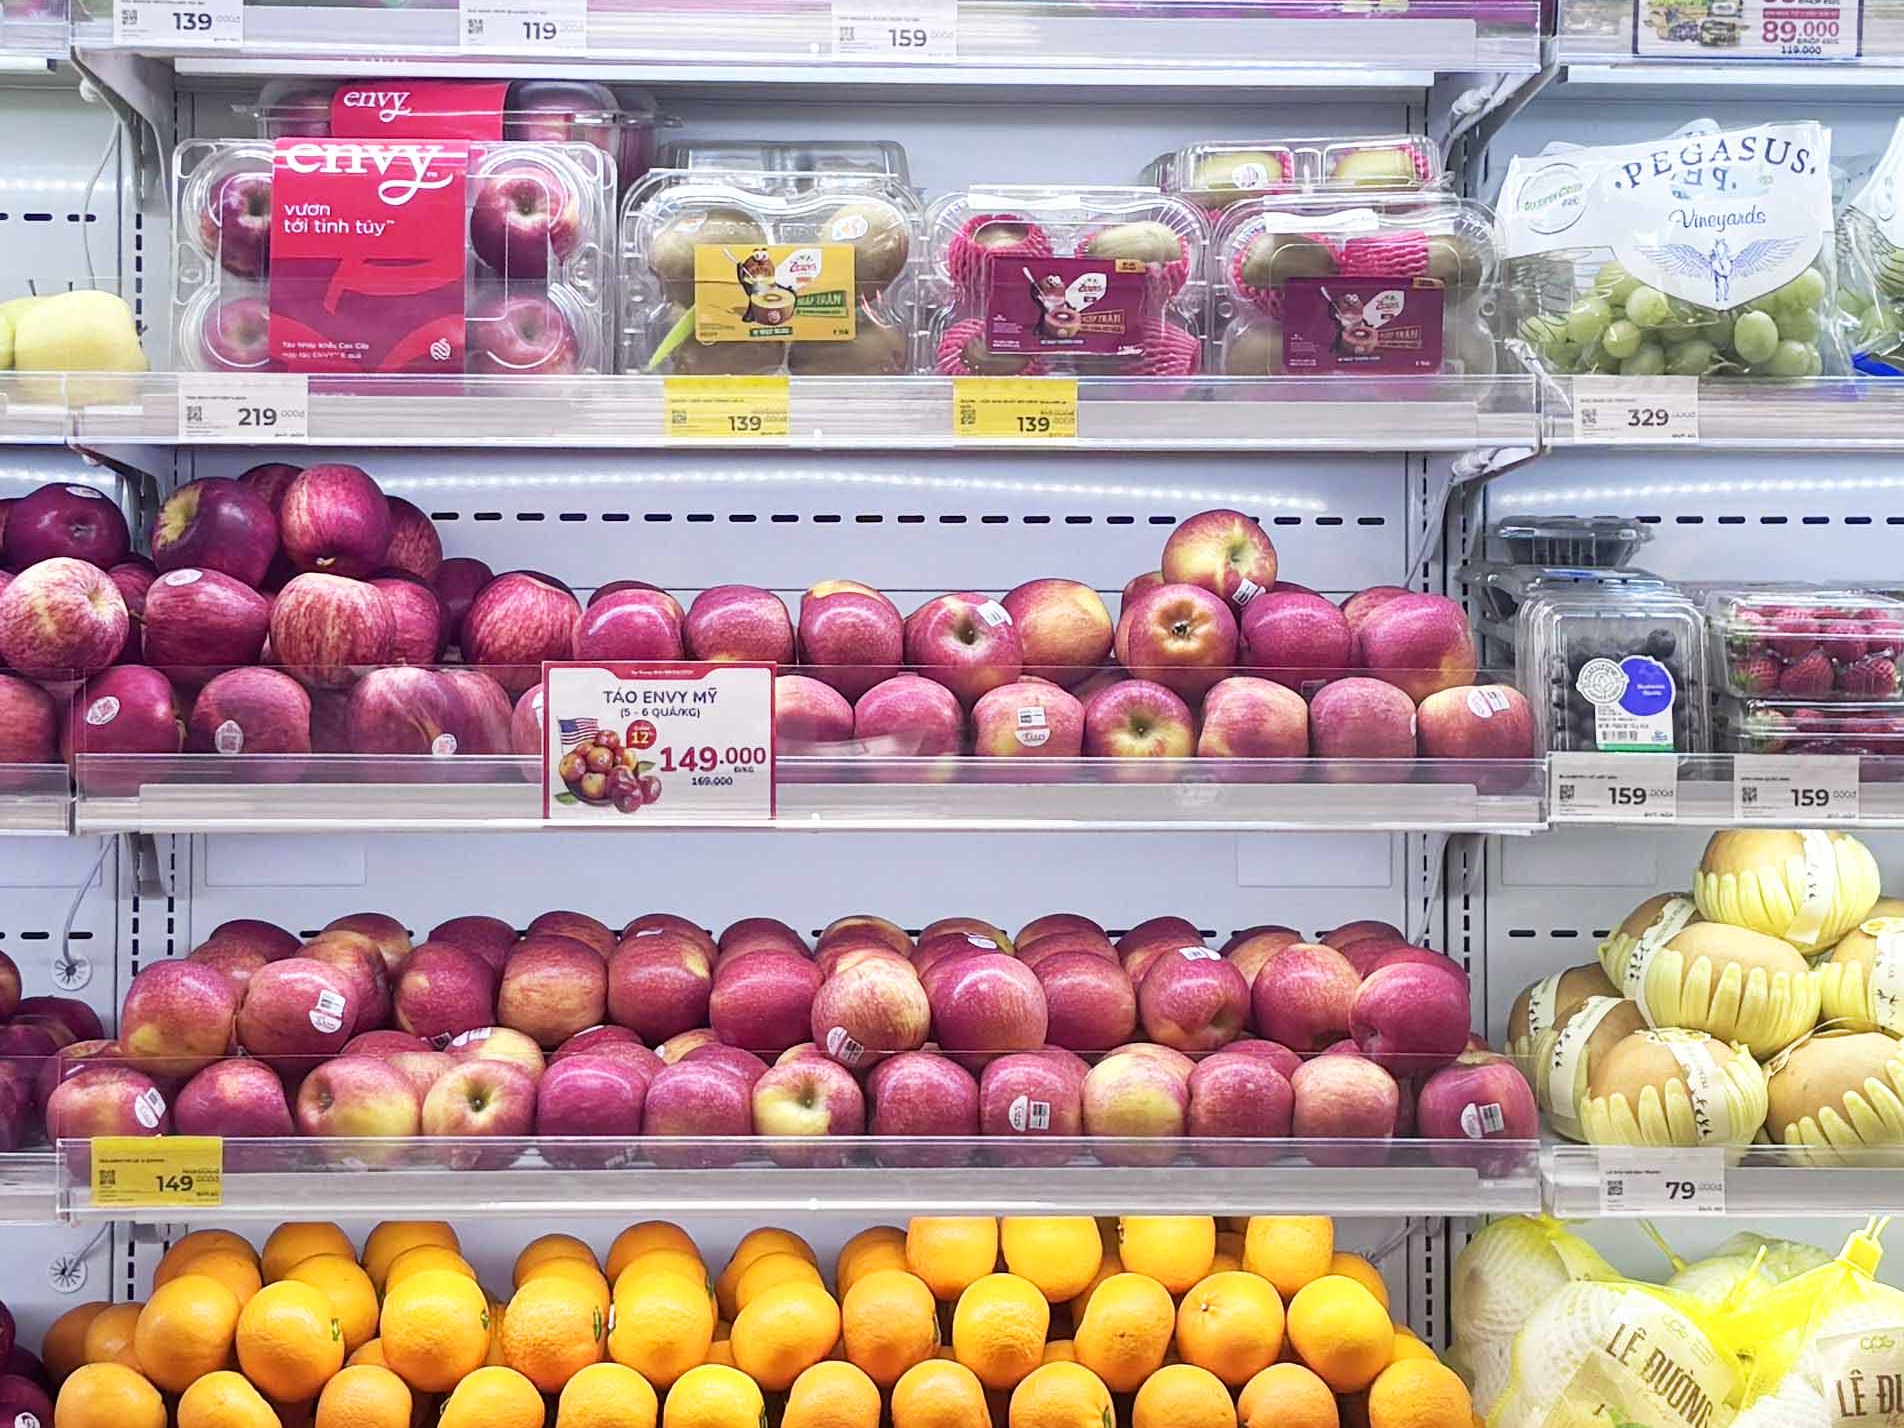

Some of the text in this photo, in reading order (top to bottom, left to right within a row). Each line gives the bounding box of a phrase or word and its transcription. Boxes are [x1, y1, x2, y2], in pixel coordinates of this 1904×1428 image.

[172, 12, 212, 29] 139
[523, 22, 557, 39] 119
[888, 29, 927, 46] 159
[1762, 21, 1840, 43] 89.000
[343, 91, 411, 122] envy
[287, 143, 454, 205] envy
[284, 202, 332, 217] vươn
[1670, 207, 1766, 230] Vineyards
[238, 408, 277, 426] 219
[728, 415, 762, 431] 139
[1017, 416, 1049, 432] 139
[1627, 408, 1669, 427] 329
[603, 687, 718, 704] TÁO ENVY MỸ
[659, 746, 766, 772] 149.000
[1608, 786, 1647, 805] 159
[1791, 789, 1829, 807] 159
[155, 1174, 193, 1192] 149
[1665, 1181, 1696, 1200] 79
[1605, 1322, 1648, 1361] LÊ
[1835, 1369, 1869, 1419] LÊ
